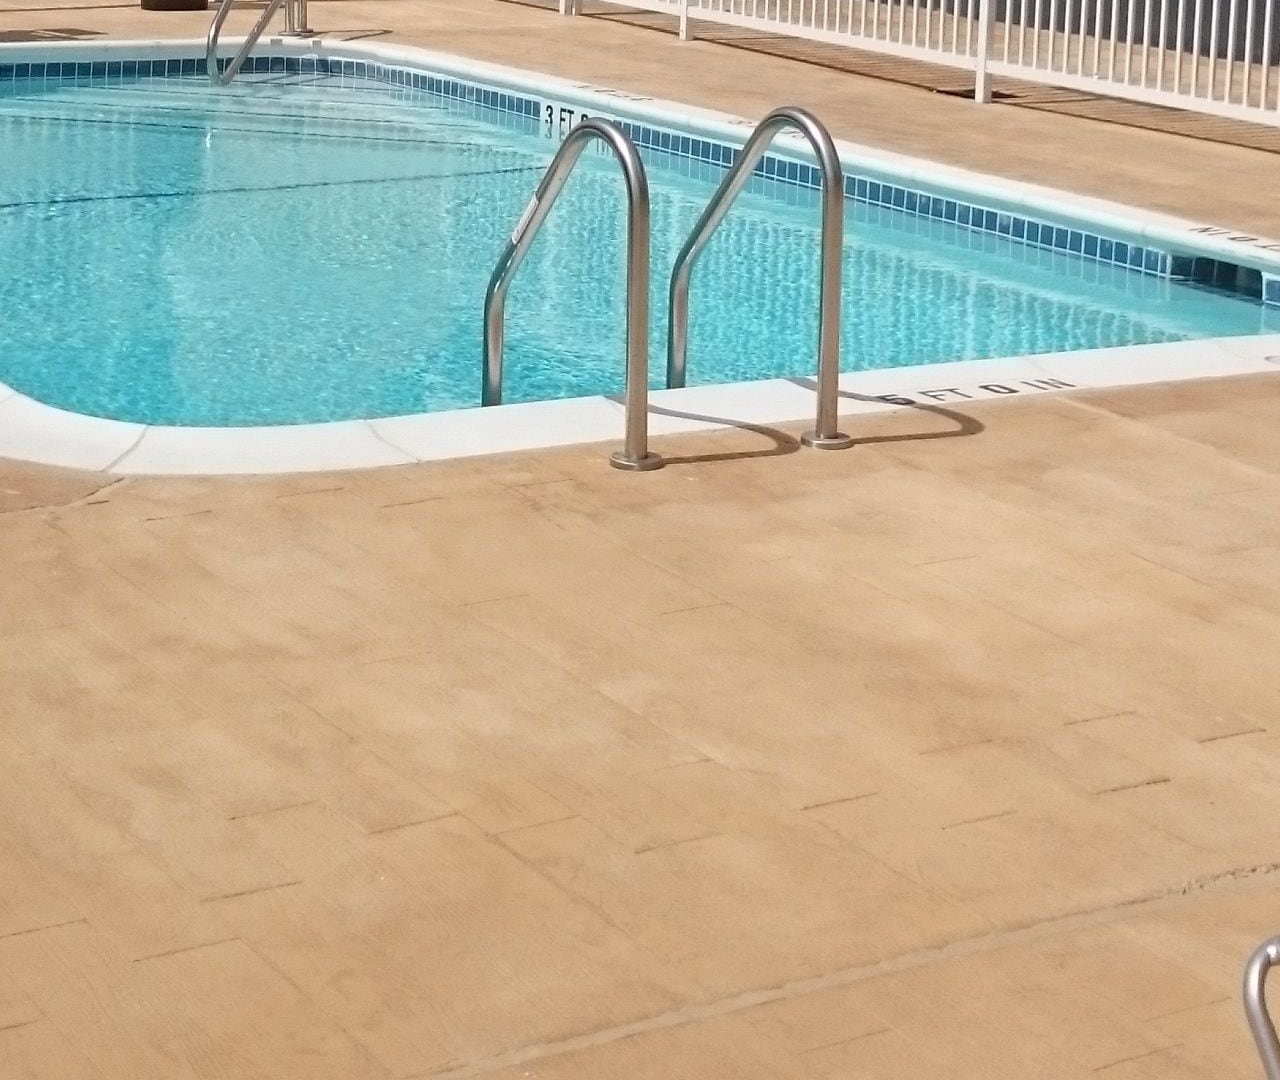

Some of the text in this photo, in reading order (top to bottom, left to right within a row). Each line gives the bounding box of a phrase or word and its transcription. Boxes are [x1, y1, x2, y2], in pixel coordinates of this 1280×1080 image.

[544, 104, 575, 131] 3 FT
[876, 377, 1077, 406] 5 FT 0 IN
